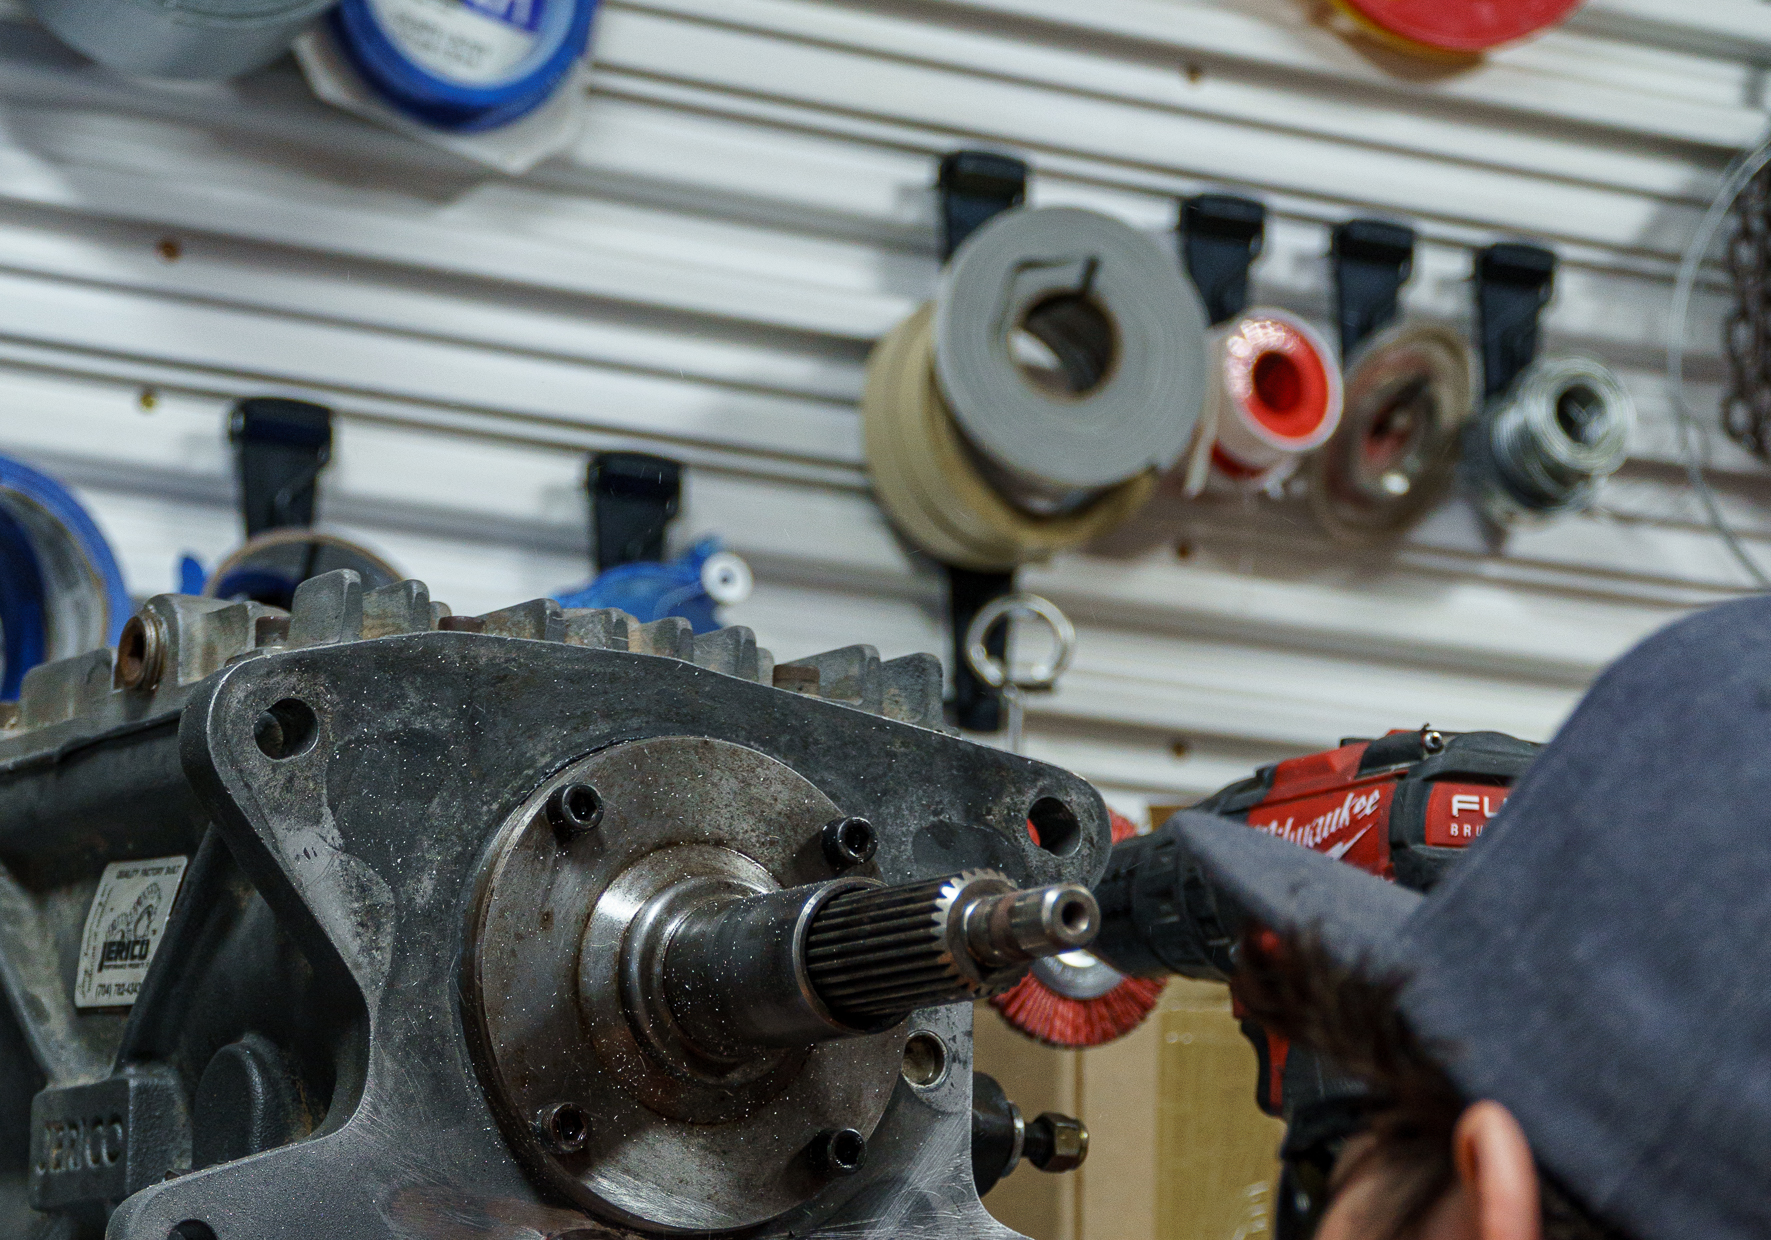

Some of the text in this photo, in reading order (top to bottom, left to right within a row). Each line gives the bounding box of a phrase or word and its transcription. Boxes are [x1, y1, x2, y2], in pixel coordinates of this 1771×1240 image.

[1255, 789, 1380, 848] lwaukee
[1451, 794, 1507, 818] FU
[97, 939, 150, 973] JERICO
[35, 1116, 123, 1176] JERICO
